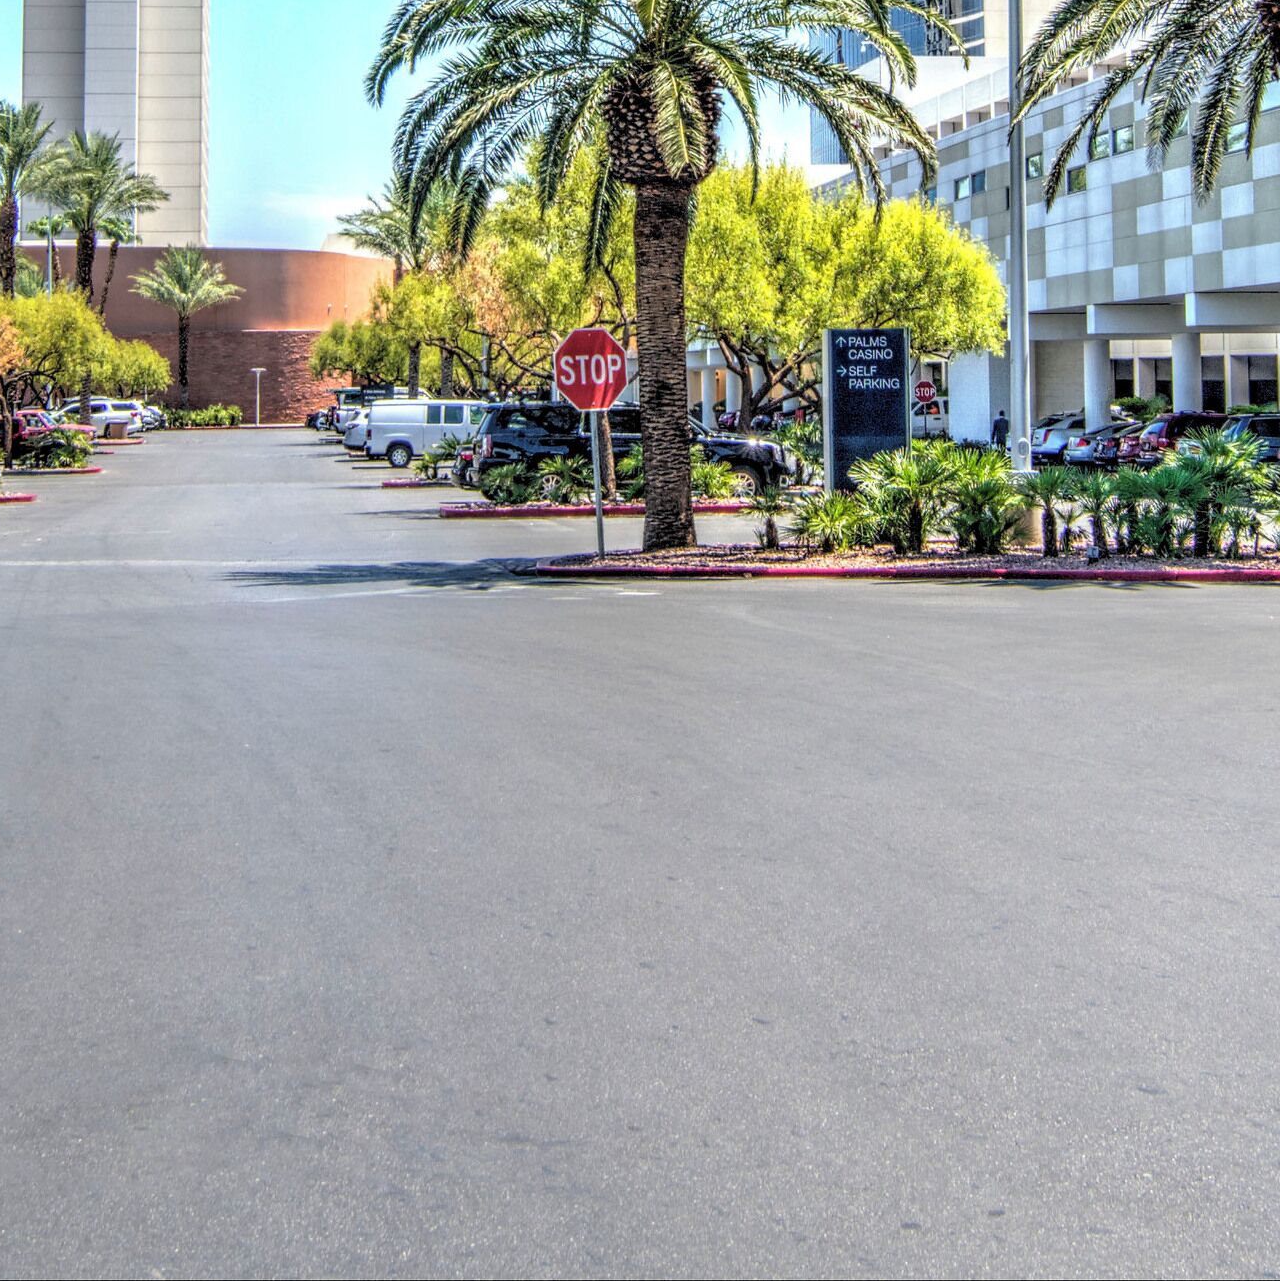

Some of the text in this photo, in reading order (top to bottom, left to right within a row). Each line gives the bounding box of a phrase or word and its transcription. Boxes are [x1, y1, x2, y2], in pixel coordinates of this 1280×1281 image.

[848, 336, 888, 347] PALMS
[848, 349, 893, 360] CASINO
[560, 354, 622, 386] STOP
[848, 366, 877, 376] SELF
[848, 379, 900, 389] PARKING
[915, 387, 937, 397] STOP
